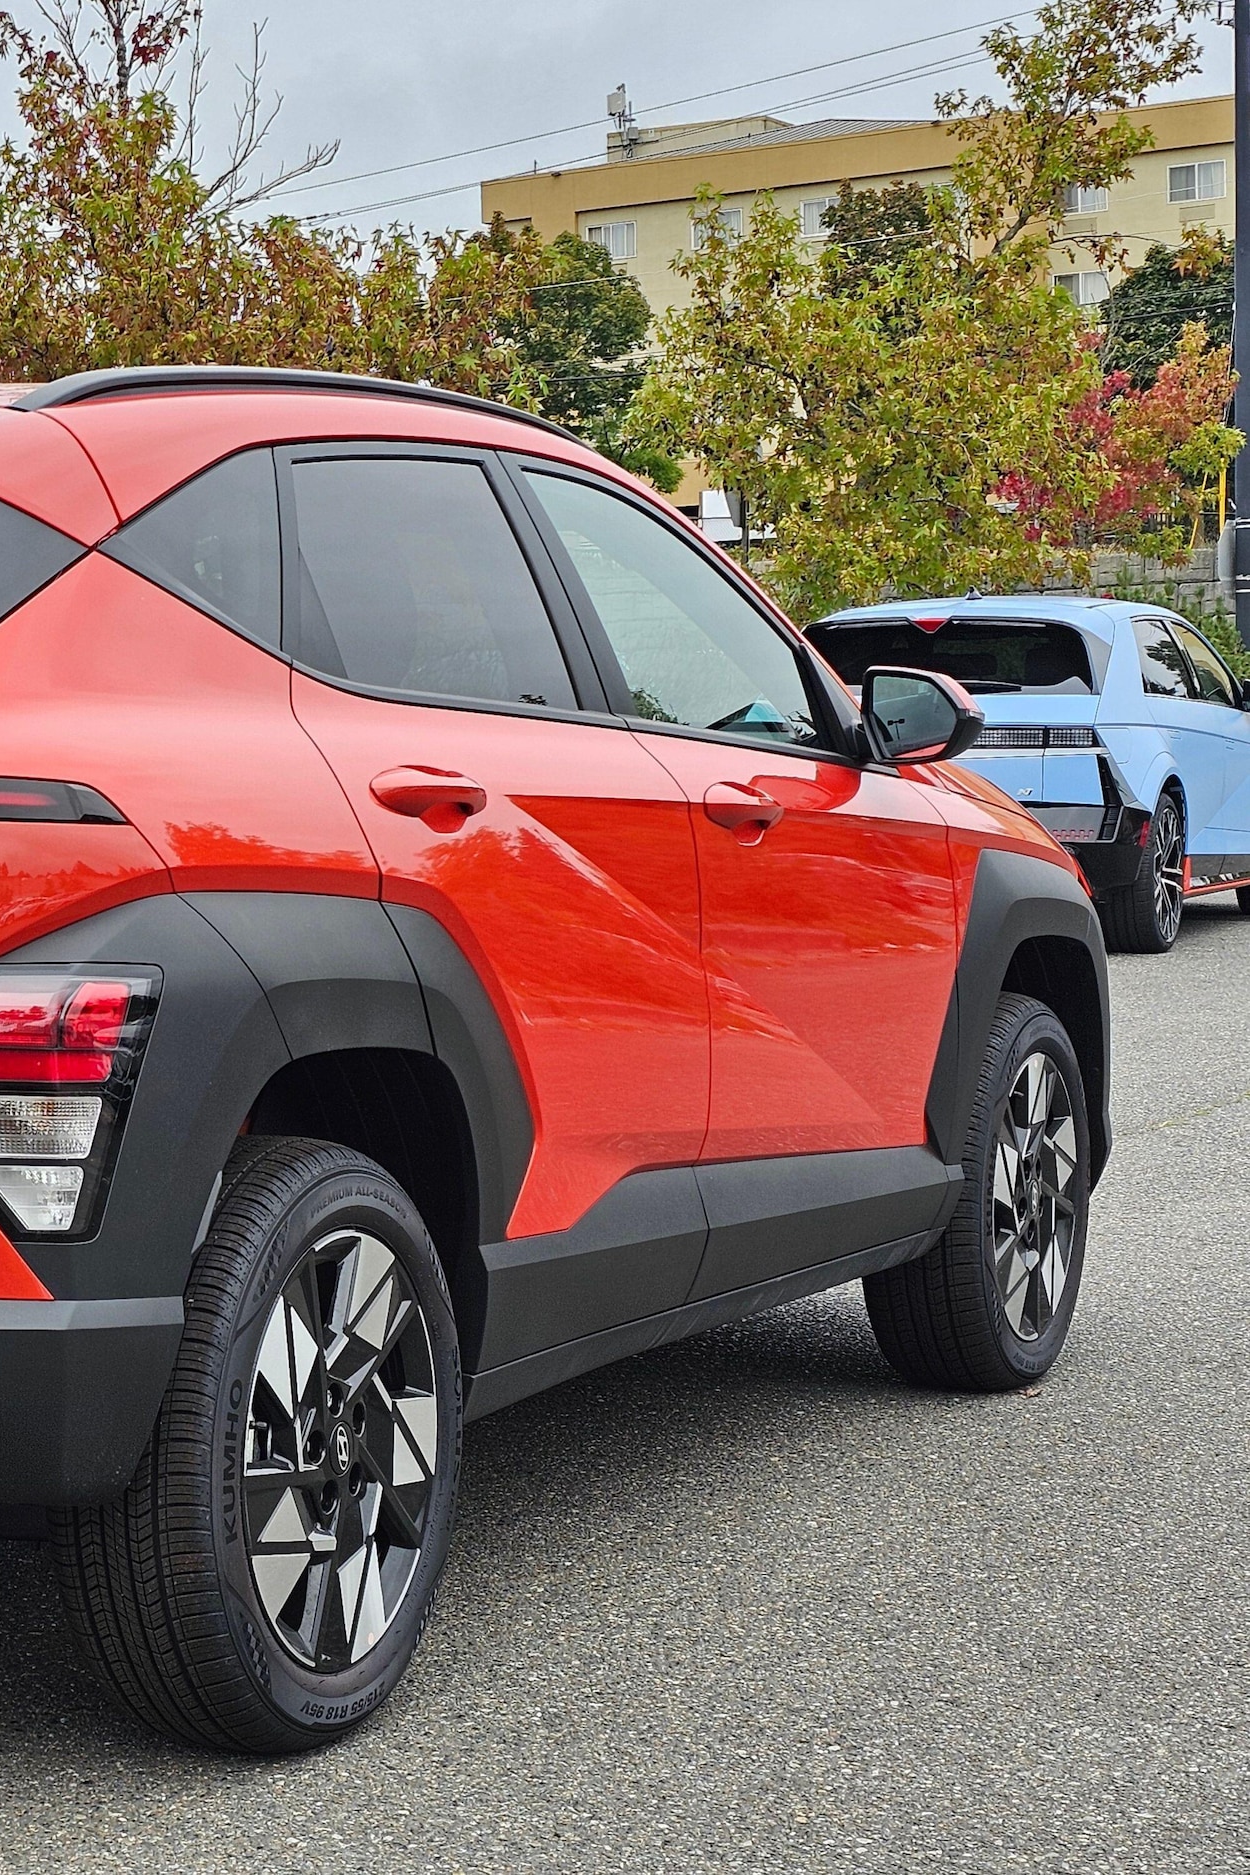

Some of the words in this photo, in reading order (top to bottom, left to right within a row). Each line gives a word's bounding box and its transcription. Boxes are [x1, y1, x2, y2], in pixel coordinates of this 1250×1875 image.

[310, 1187, 353, 1218] PREMIUM
[222, 1379, 243, 1544] KUMHO
[300, 1700, 325, 1719] 95V
[325, 1705, 349, 1720] R18
[350, 1681, 386, 1715] 215/55
